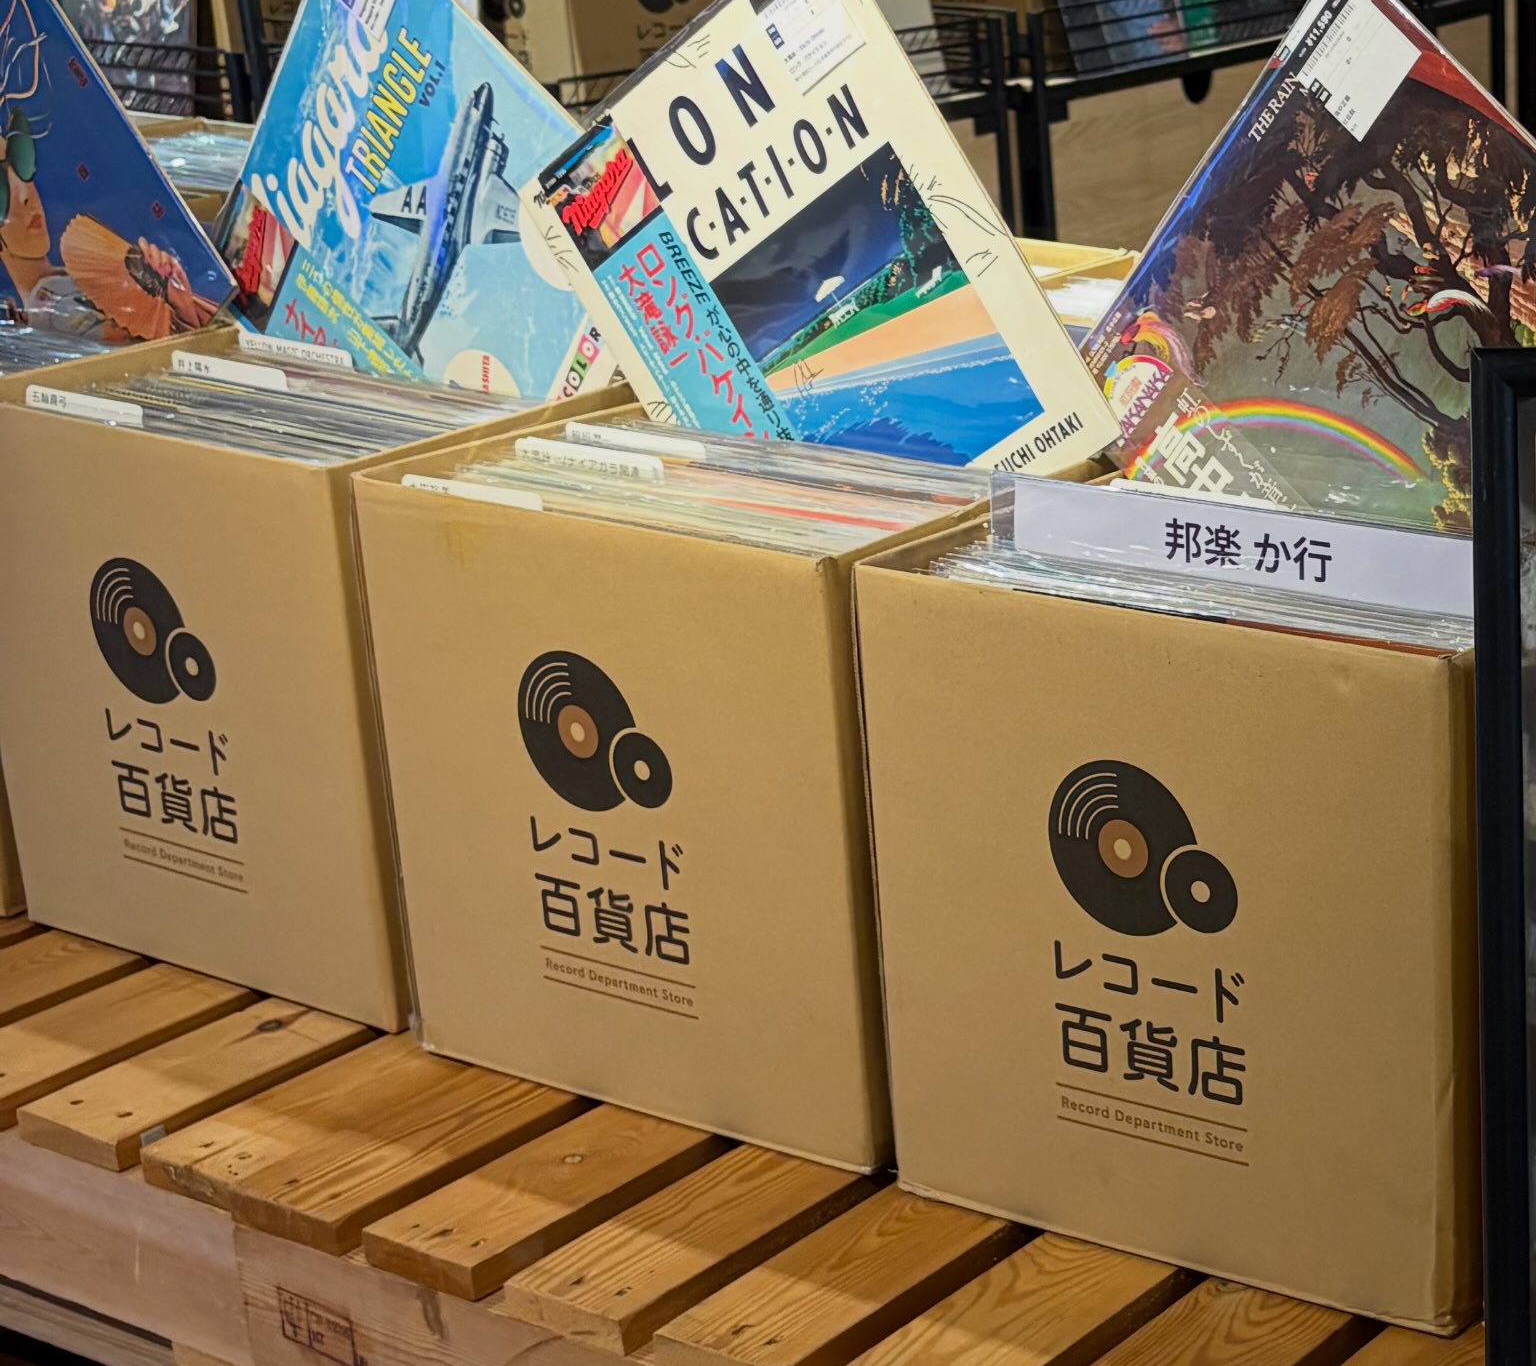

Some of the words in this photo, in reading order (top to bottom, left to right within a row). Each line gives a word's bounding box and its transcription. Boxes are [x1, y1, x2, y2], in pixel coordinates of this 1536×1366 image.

[1304, 9, 1334, 47] ¥11,590
[345, 26, 433, 195] TRIANGLE
[1247, 108, 1277, 143] THE
[1269, 71, 1301, 120] RAIN
[561, 147, 632, 237] Niagara
[1034, 411, 1085, 455] OHTAKI
[1165, 517, 1242, 567] 邦楽
[1253, 532, 1333, 583] か行
[105, 707, 229, 777] レコード
[111, 758, 239, 845] 百貨店
[530, 815, 684, 891] レコード
[534, 872, 691, 966] 百貨店
[1053, 939, 1246, 1024] レコード
[1054, 1002, 1247, 1106] 百貨店
[1060, 1095, 1111, 1119] Record
[1114, 1109, 1200, 1143] Department
[1204, 1131, 1245, 1153] Store
